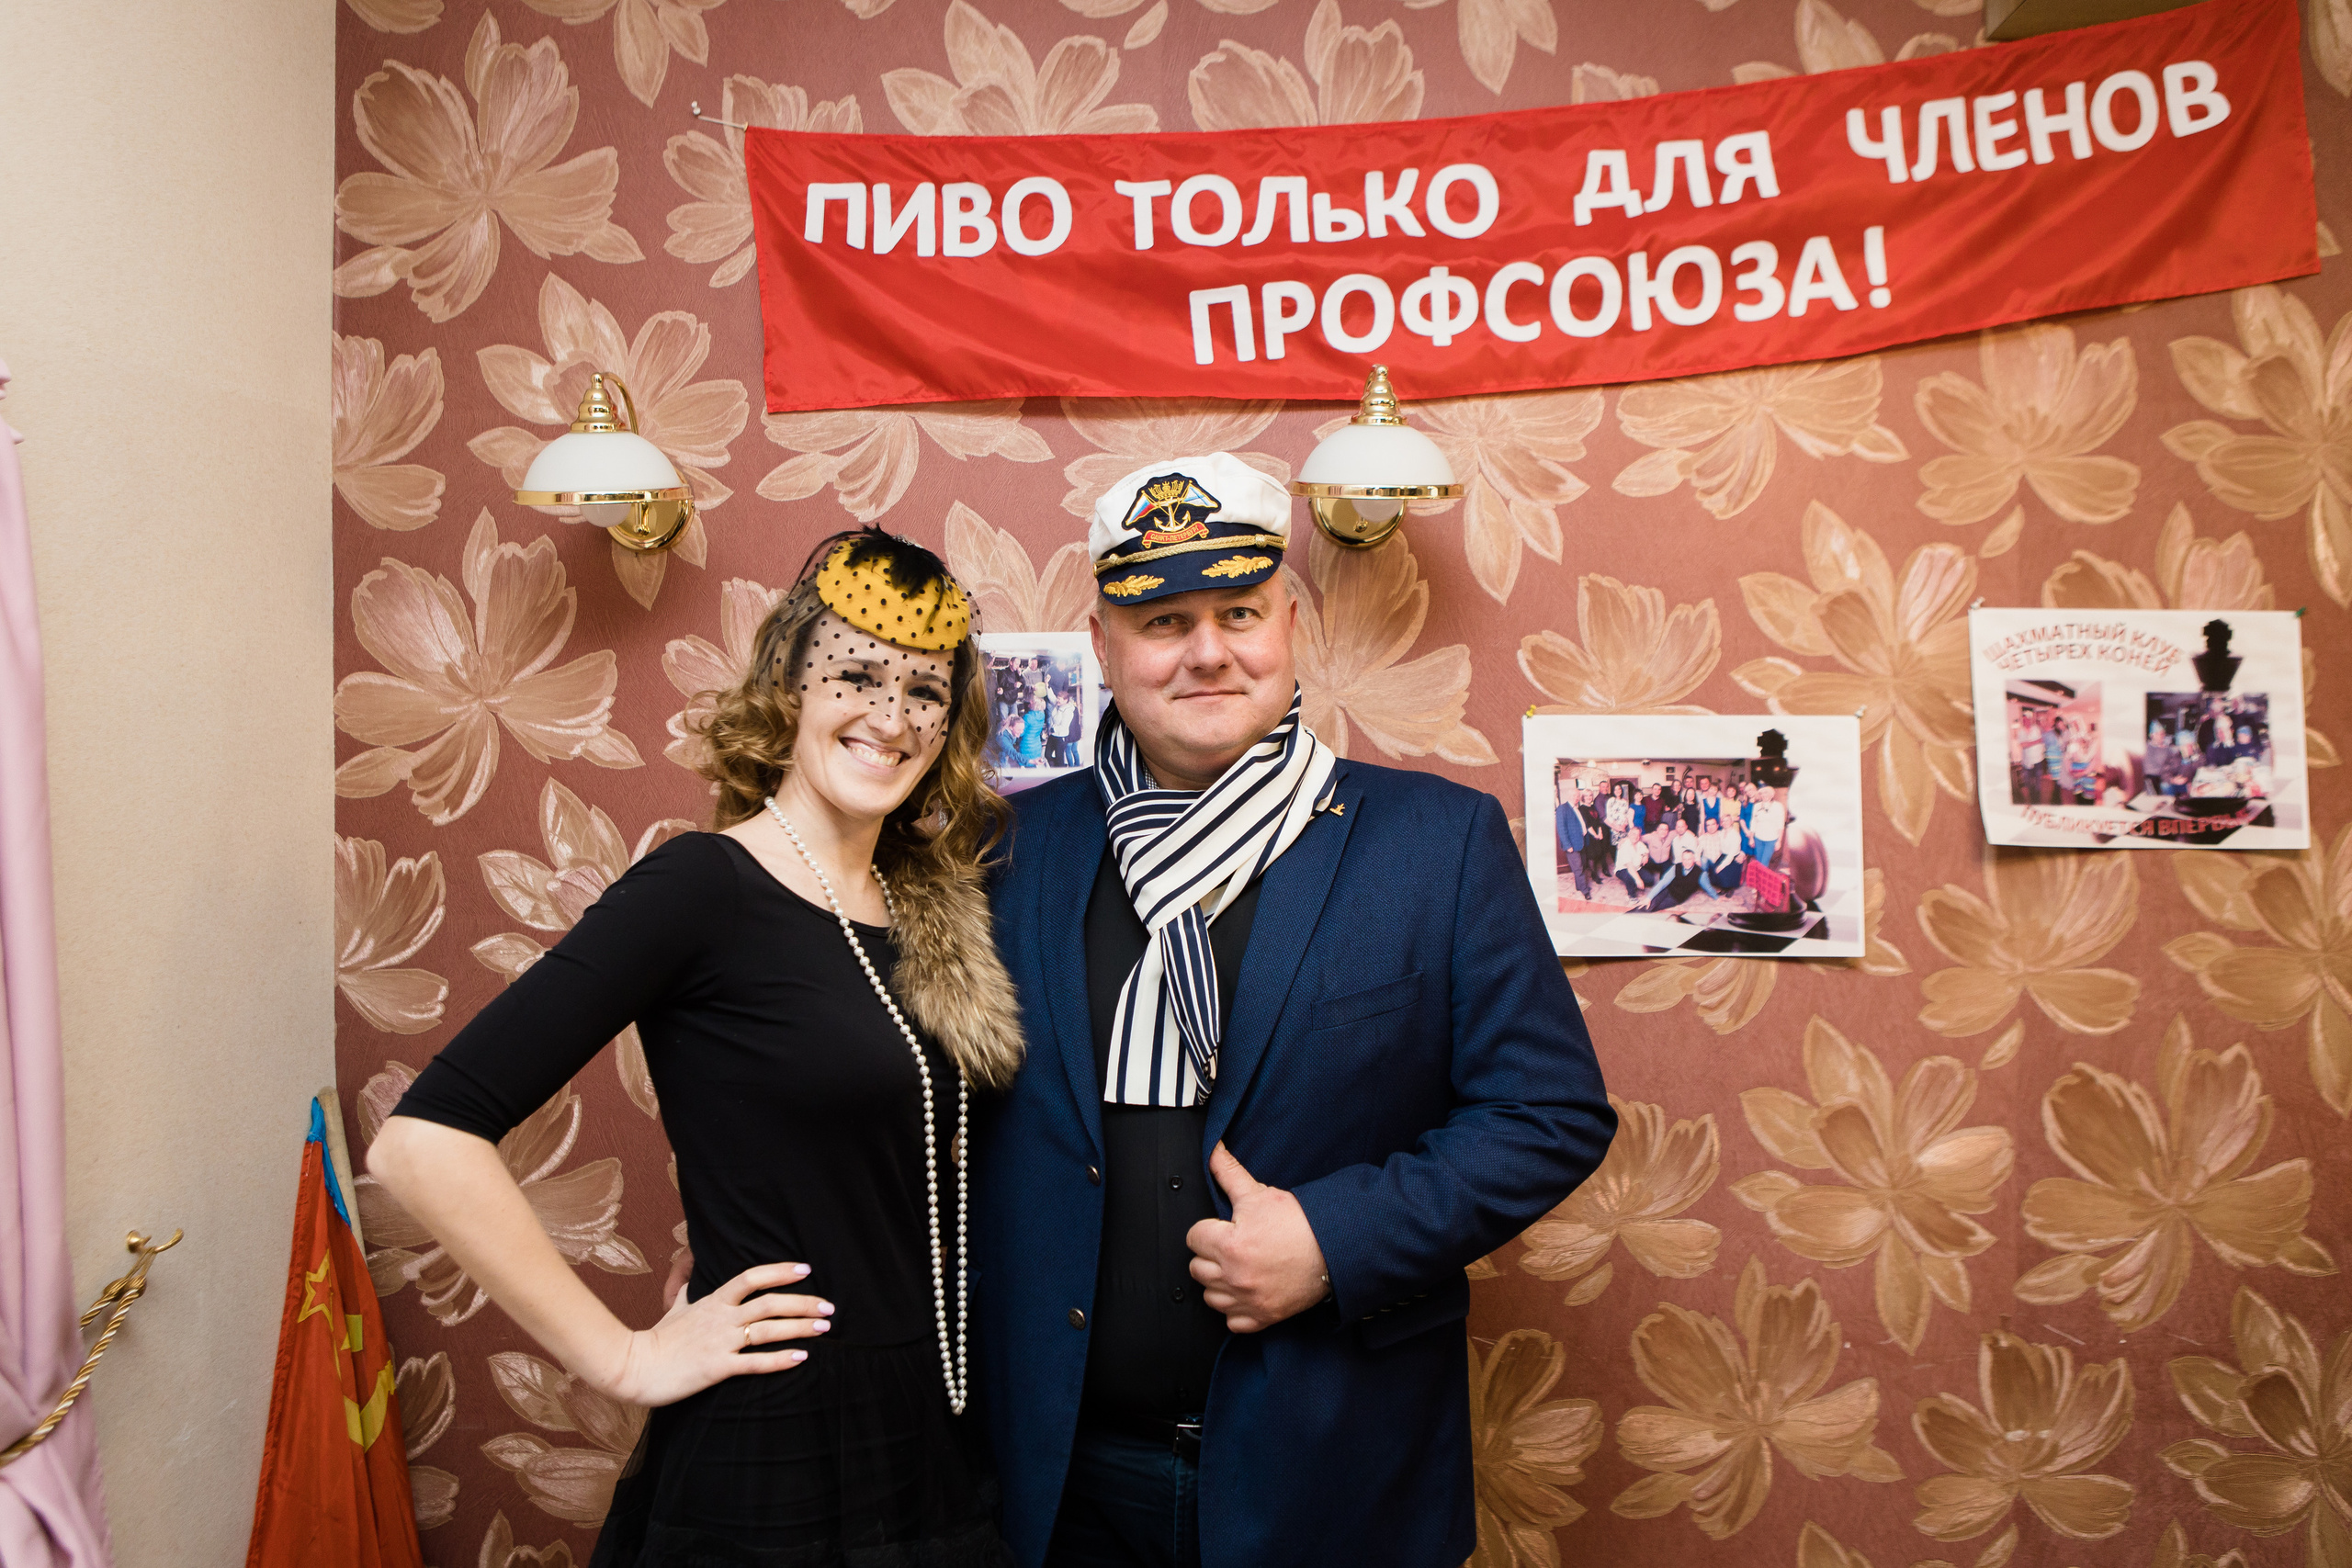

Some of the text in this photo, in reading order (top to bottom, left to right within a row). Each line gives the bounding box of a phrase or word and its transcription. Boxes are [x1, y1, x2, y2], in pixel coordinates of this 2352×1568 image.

[804, 176, 1073, 257] ПИВО
[1573, 130, 1781, 226] ДЛЯ
[1847, 61, 2231, 184] ЧЛЕНОВ
[1189, 226, 1892, 366] ПРОФСОЮЗА!
[1150, 525, 1199, 541] САНКТ-ПЕТЕРБУРГ
[1982, 621, 2186, 665] ШАХМАТНЫЙ КЛУБ
[2097, 644, 2172, 678] КОНЕЙ
